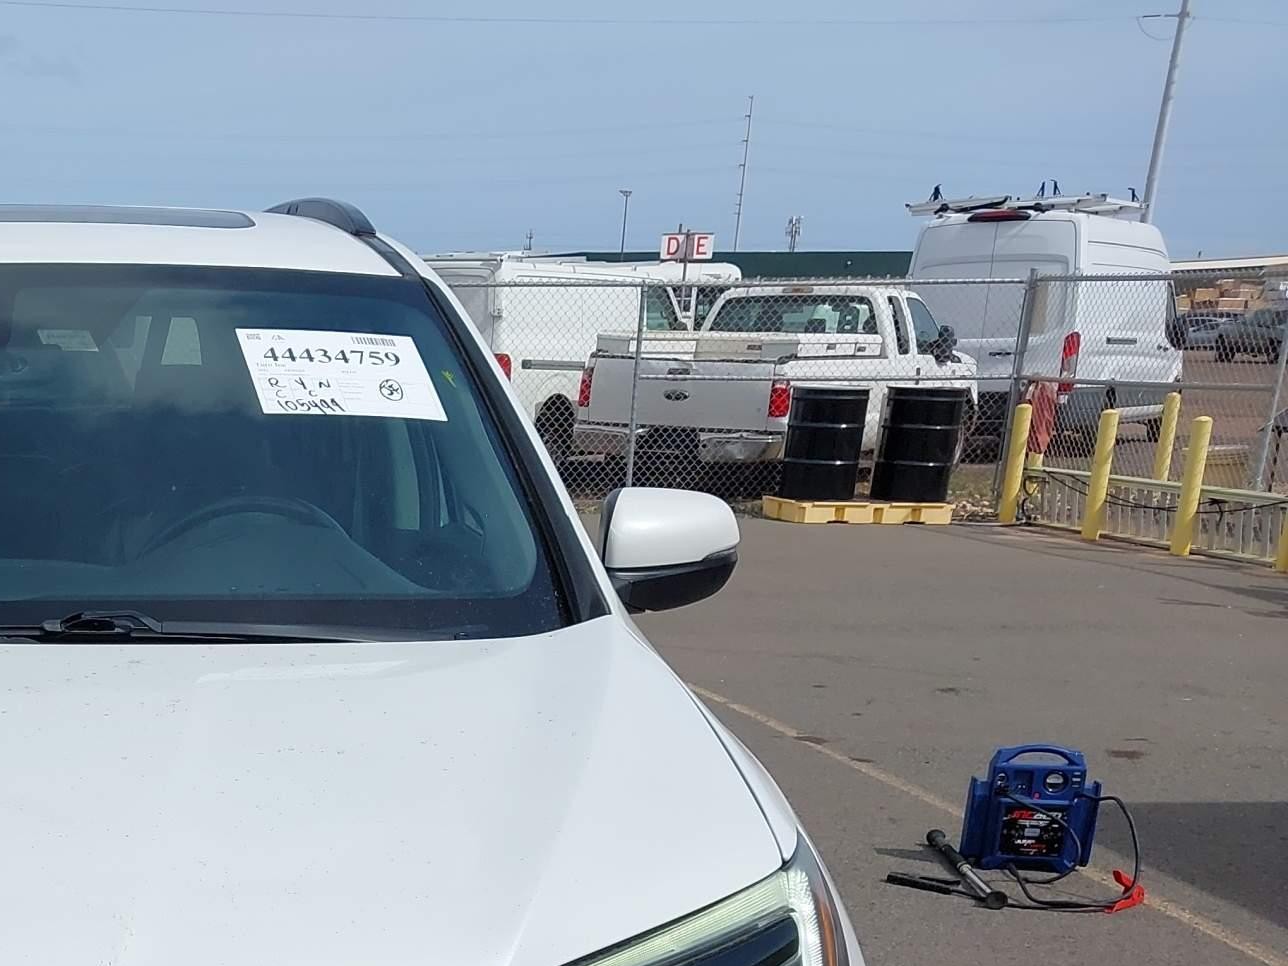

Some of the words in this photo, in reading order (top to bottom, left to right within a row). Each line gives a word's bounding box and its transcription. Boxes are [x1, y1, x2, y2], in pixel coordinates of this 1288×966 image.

[667, 236, 681, 256] D
[695, 236, 709, 255] E
[263, 346, 400, 367] 44434759
